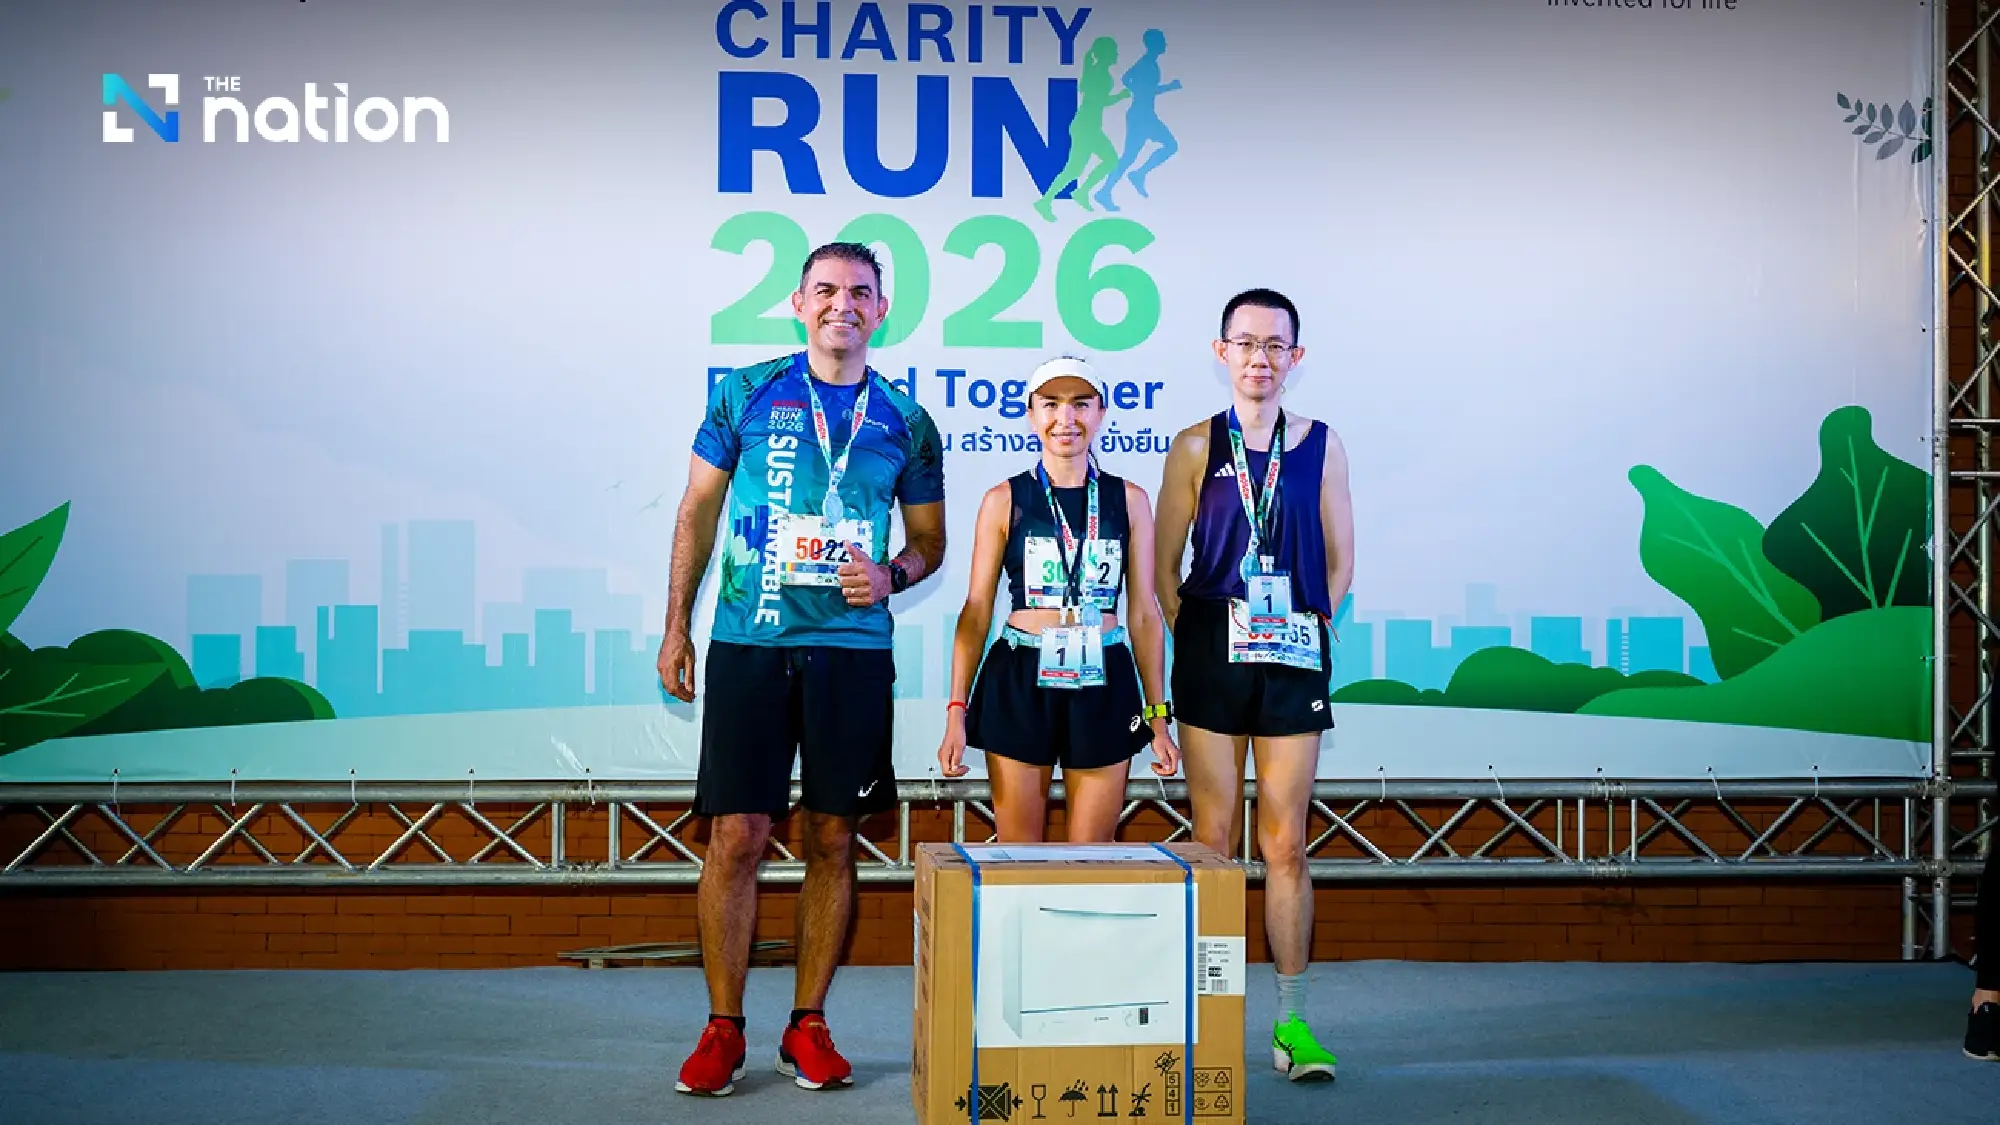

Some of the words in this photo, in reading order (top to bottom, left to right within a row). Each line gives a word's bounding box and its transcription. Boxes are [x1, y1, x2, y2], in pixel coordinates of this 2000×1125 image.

[715, 0, 1093, 65] CHARITY
[717, 72, 1078, 199] RUN
[710, 211, 1161, 351] 2026
[1262, 593, 1272, 614] 1
[1055, 647, 1066, 667] 1
